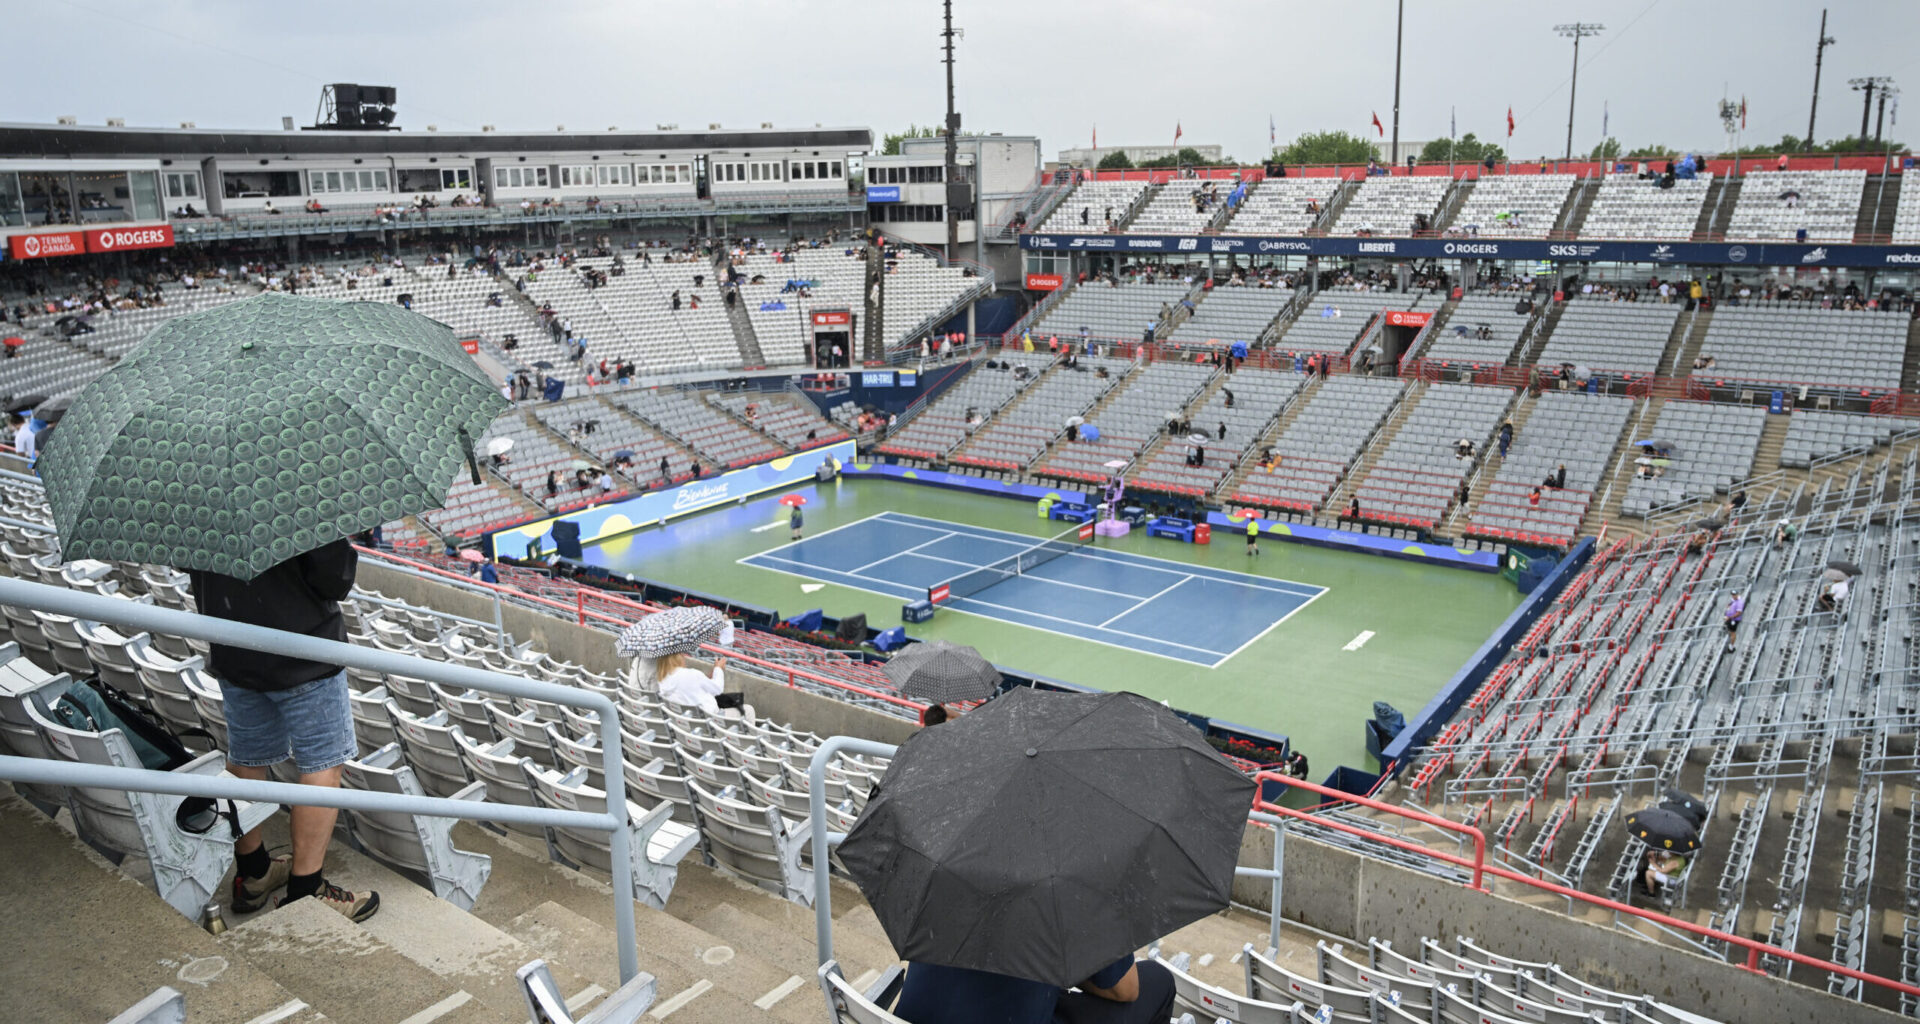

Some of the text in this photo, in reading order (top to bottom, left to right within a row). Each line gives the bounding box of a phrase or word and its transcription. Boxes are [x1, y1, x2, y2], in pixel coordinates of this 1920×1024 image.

[41, 235, 71, 244] TENNIS
[116, 230, 165, 246] ROGERS
[42, 243, 75, 254] CANADA
[1129, 240, 1162, 248] BARBADOS
[1178, 239, 1198, 250] IGA
[1267, 241, 1307, 250] ABRYSVO
[1359, 242, 1396, 252] LIBERTÉ
[1456, 244, 1498, 254] ROGERS
[1550, 245, 1577, 256] SKS
[1886, 252, 1920, 263] redta
[1036, 278, 1059, 286] ROGERS
[862, 373, 893, 385] HAR-TRU
